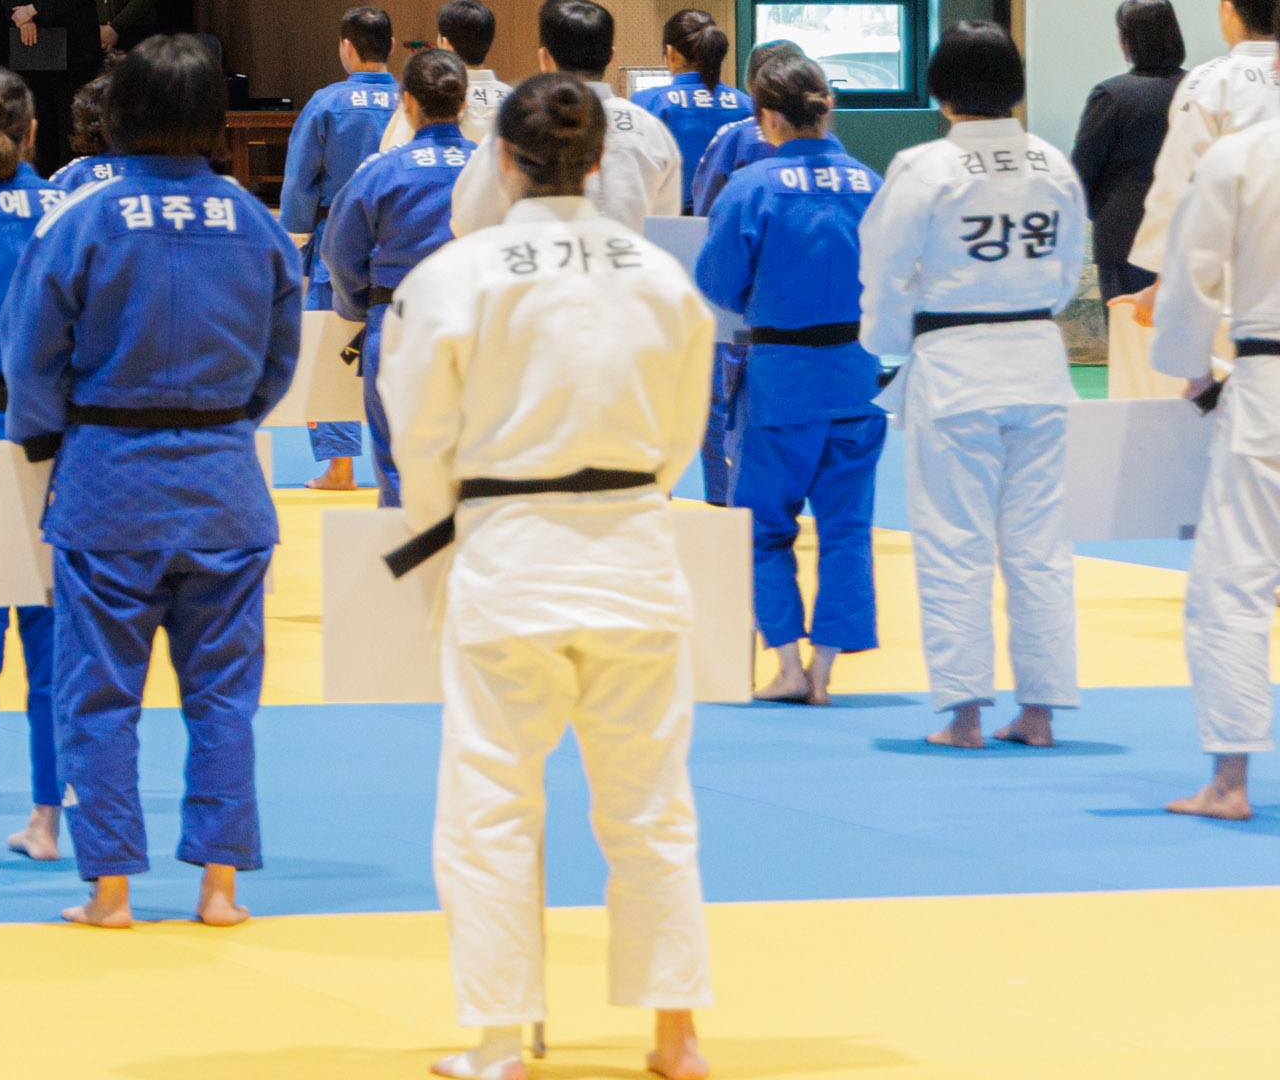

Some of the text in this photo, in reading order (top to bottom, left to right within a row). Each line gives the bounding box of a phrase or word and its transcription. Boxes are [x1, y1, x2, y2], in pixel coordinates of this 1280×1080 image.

[349, 89, 397, 109] 심재
[666, 89, 738, 109] 이윤선
[410, 146, 466, 167] 정승
[959, 150, 1050, 175] 김도연
[119, 194, 236, 231] 김주희
[961, 210, 1059, 263] 강원
[500, 237, 643, 275] 장가은
